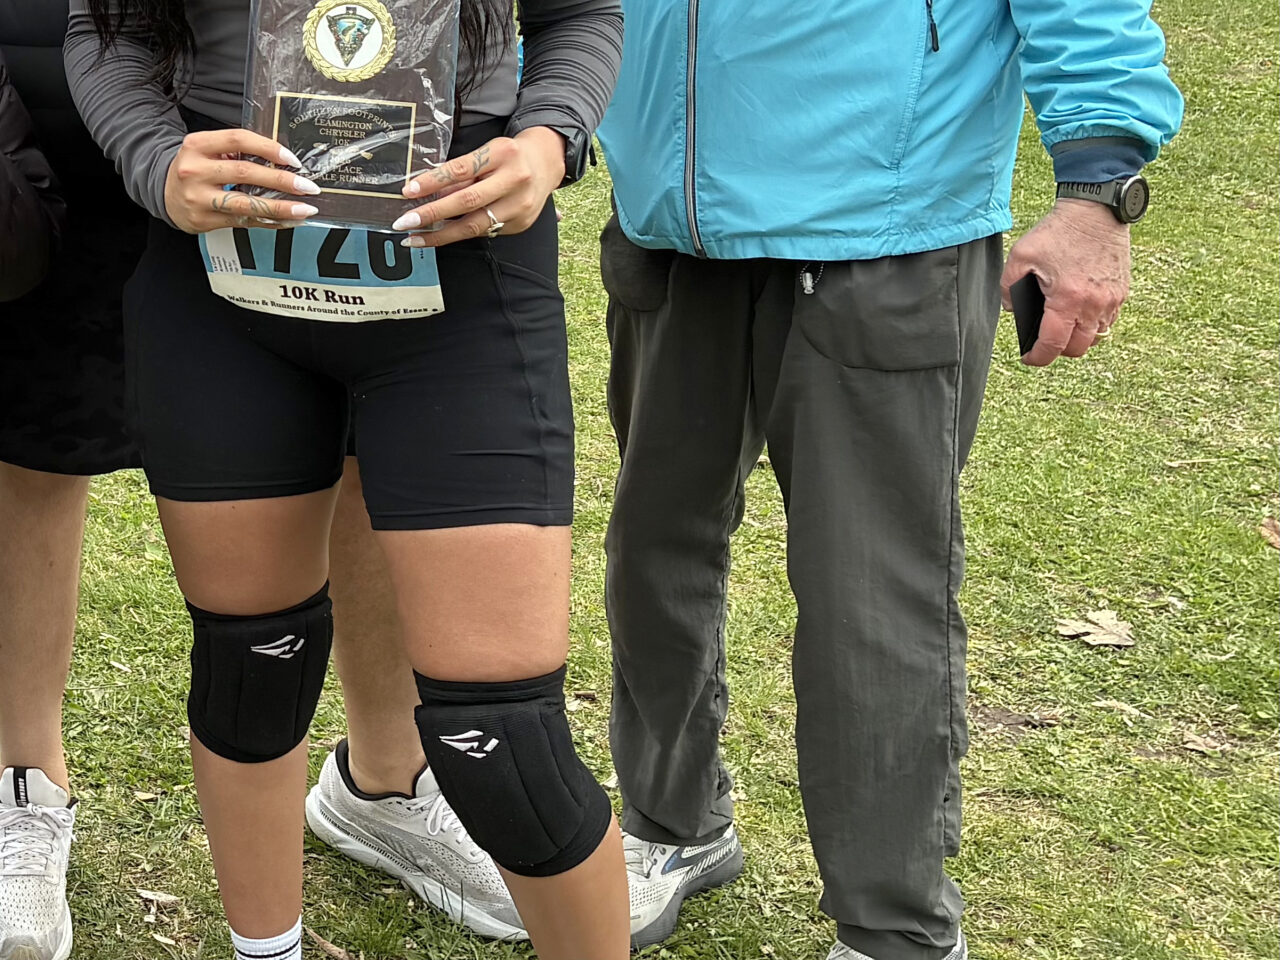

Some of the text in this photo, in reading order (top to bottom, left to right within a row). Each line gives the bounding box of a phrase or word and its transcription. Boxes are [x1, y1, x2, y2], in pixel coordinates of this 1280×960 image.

[314, 118, 373, 130] LEAMINGTON
[319, 127, 366, 139] CHRYSLER
[334, 138, 350, 147] 10K
[278, 284, 366, 306] 10K Run
[226, 294, 260, 306] Walkers
[261, 298, 269, 307] &
[270, 300, 305, 312] Runners
[306, 305, 339, 316] Around
[340, 308, 356, 316] the
[357, 308, 389, 318] County
[391, 308, 402, 316] of
